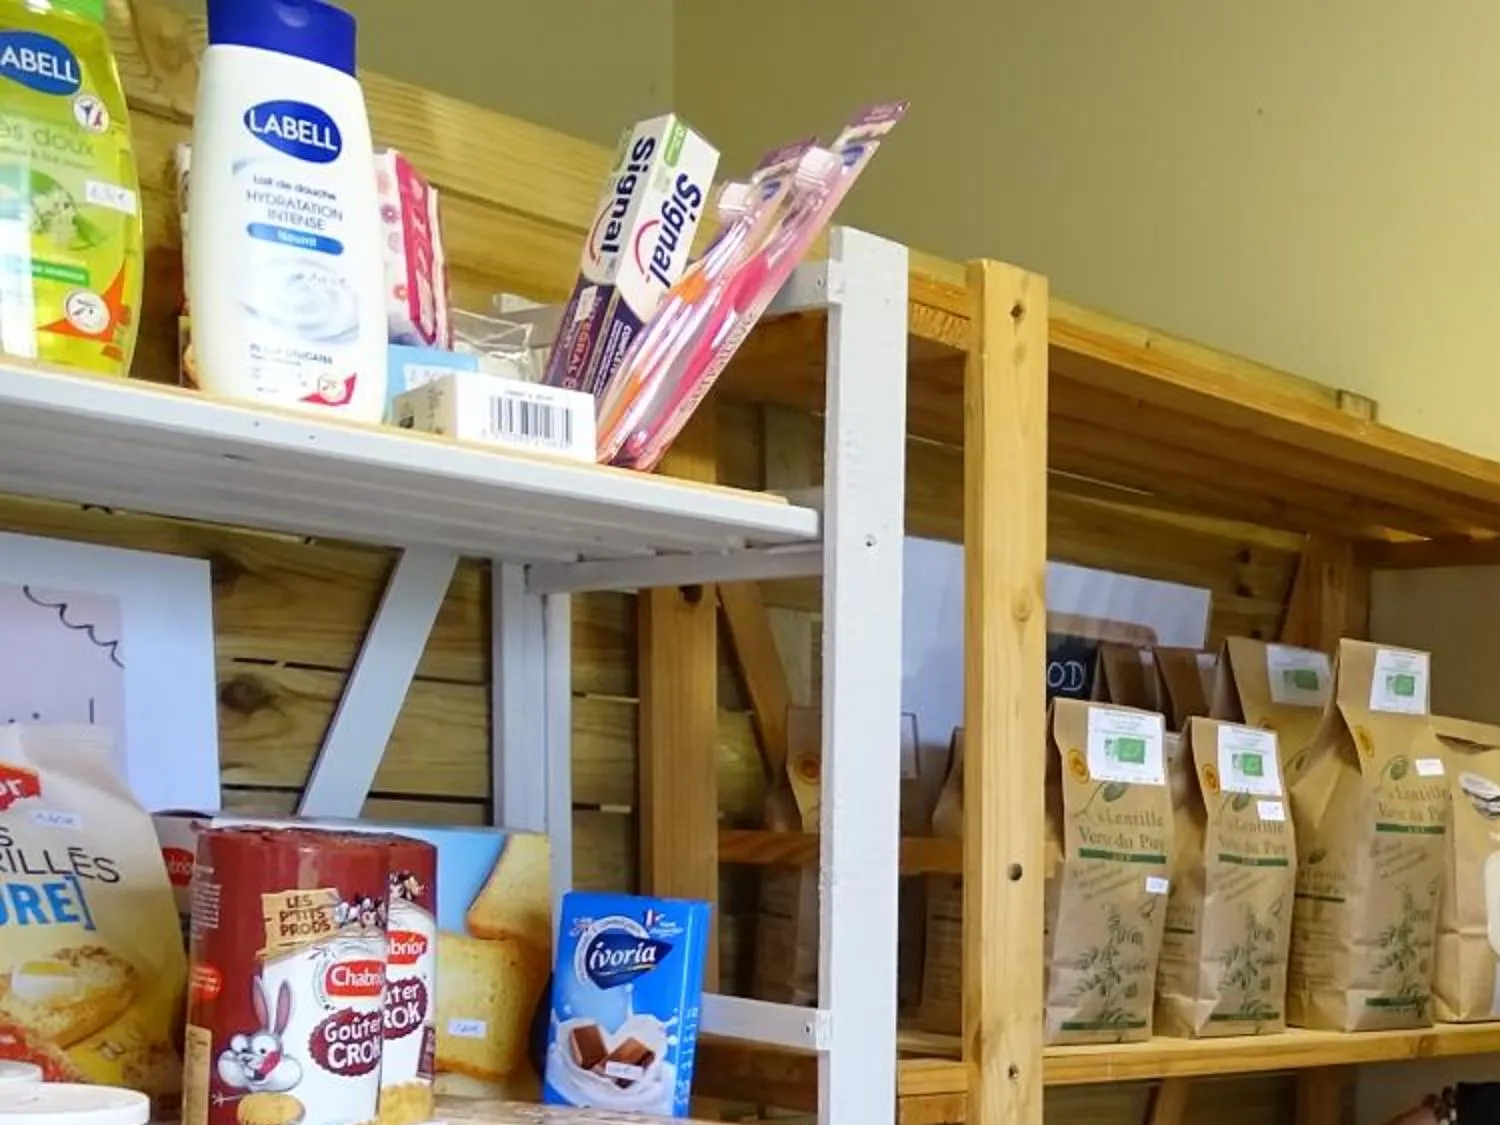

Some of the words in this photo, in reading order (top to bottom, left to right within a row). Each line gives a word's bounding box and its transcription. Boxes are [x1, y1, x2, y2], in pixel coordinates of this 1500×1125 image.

[0, 45, 79, 84] ABELL
[250, 109, 338, 151] LABELL
[246, 189, 343, 221] HYDRATATION
[601, 136, 656, 253] Signal
[267, 207, 326, 231] INTENSE
[648, 173, 702, 288] Signal
[286, 896, 313, 909] LES
[383, 1001, 421, 1029] ROK
